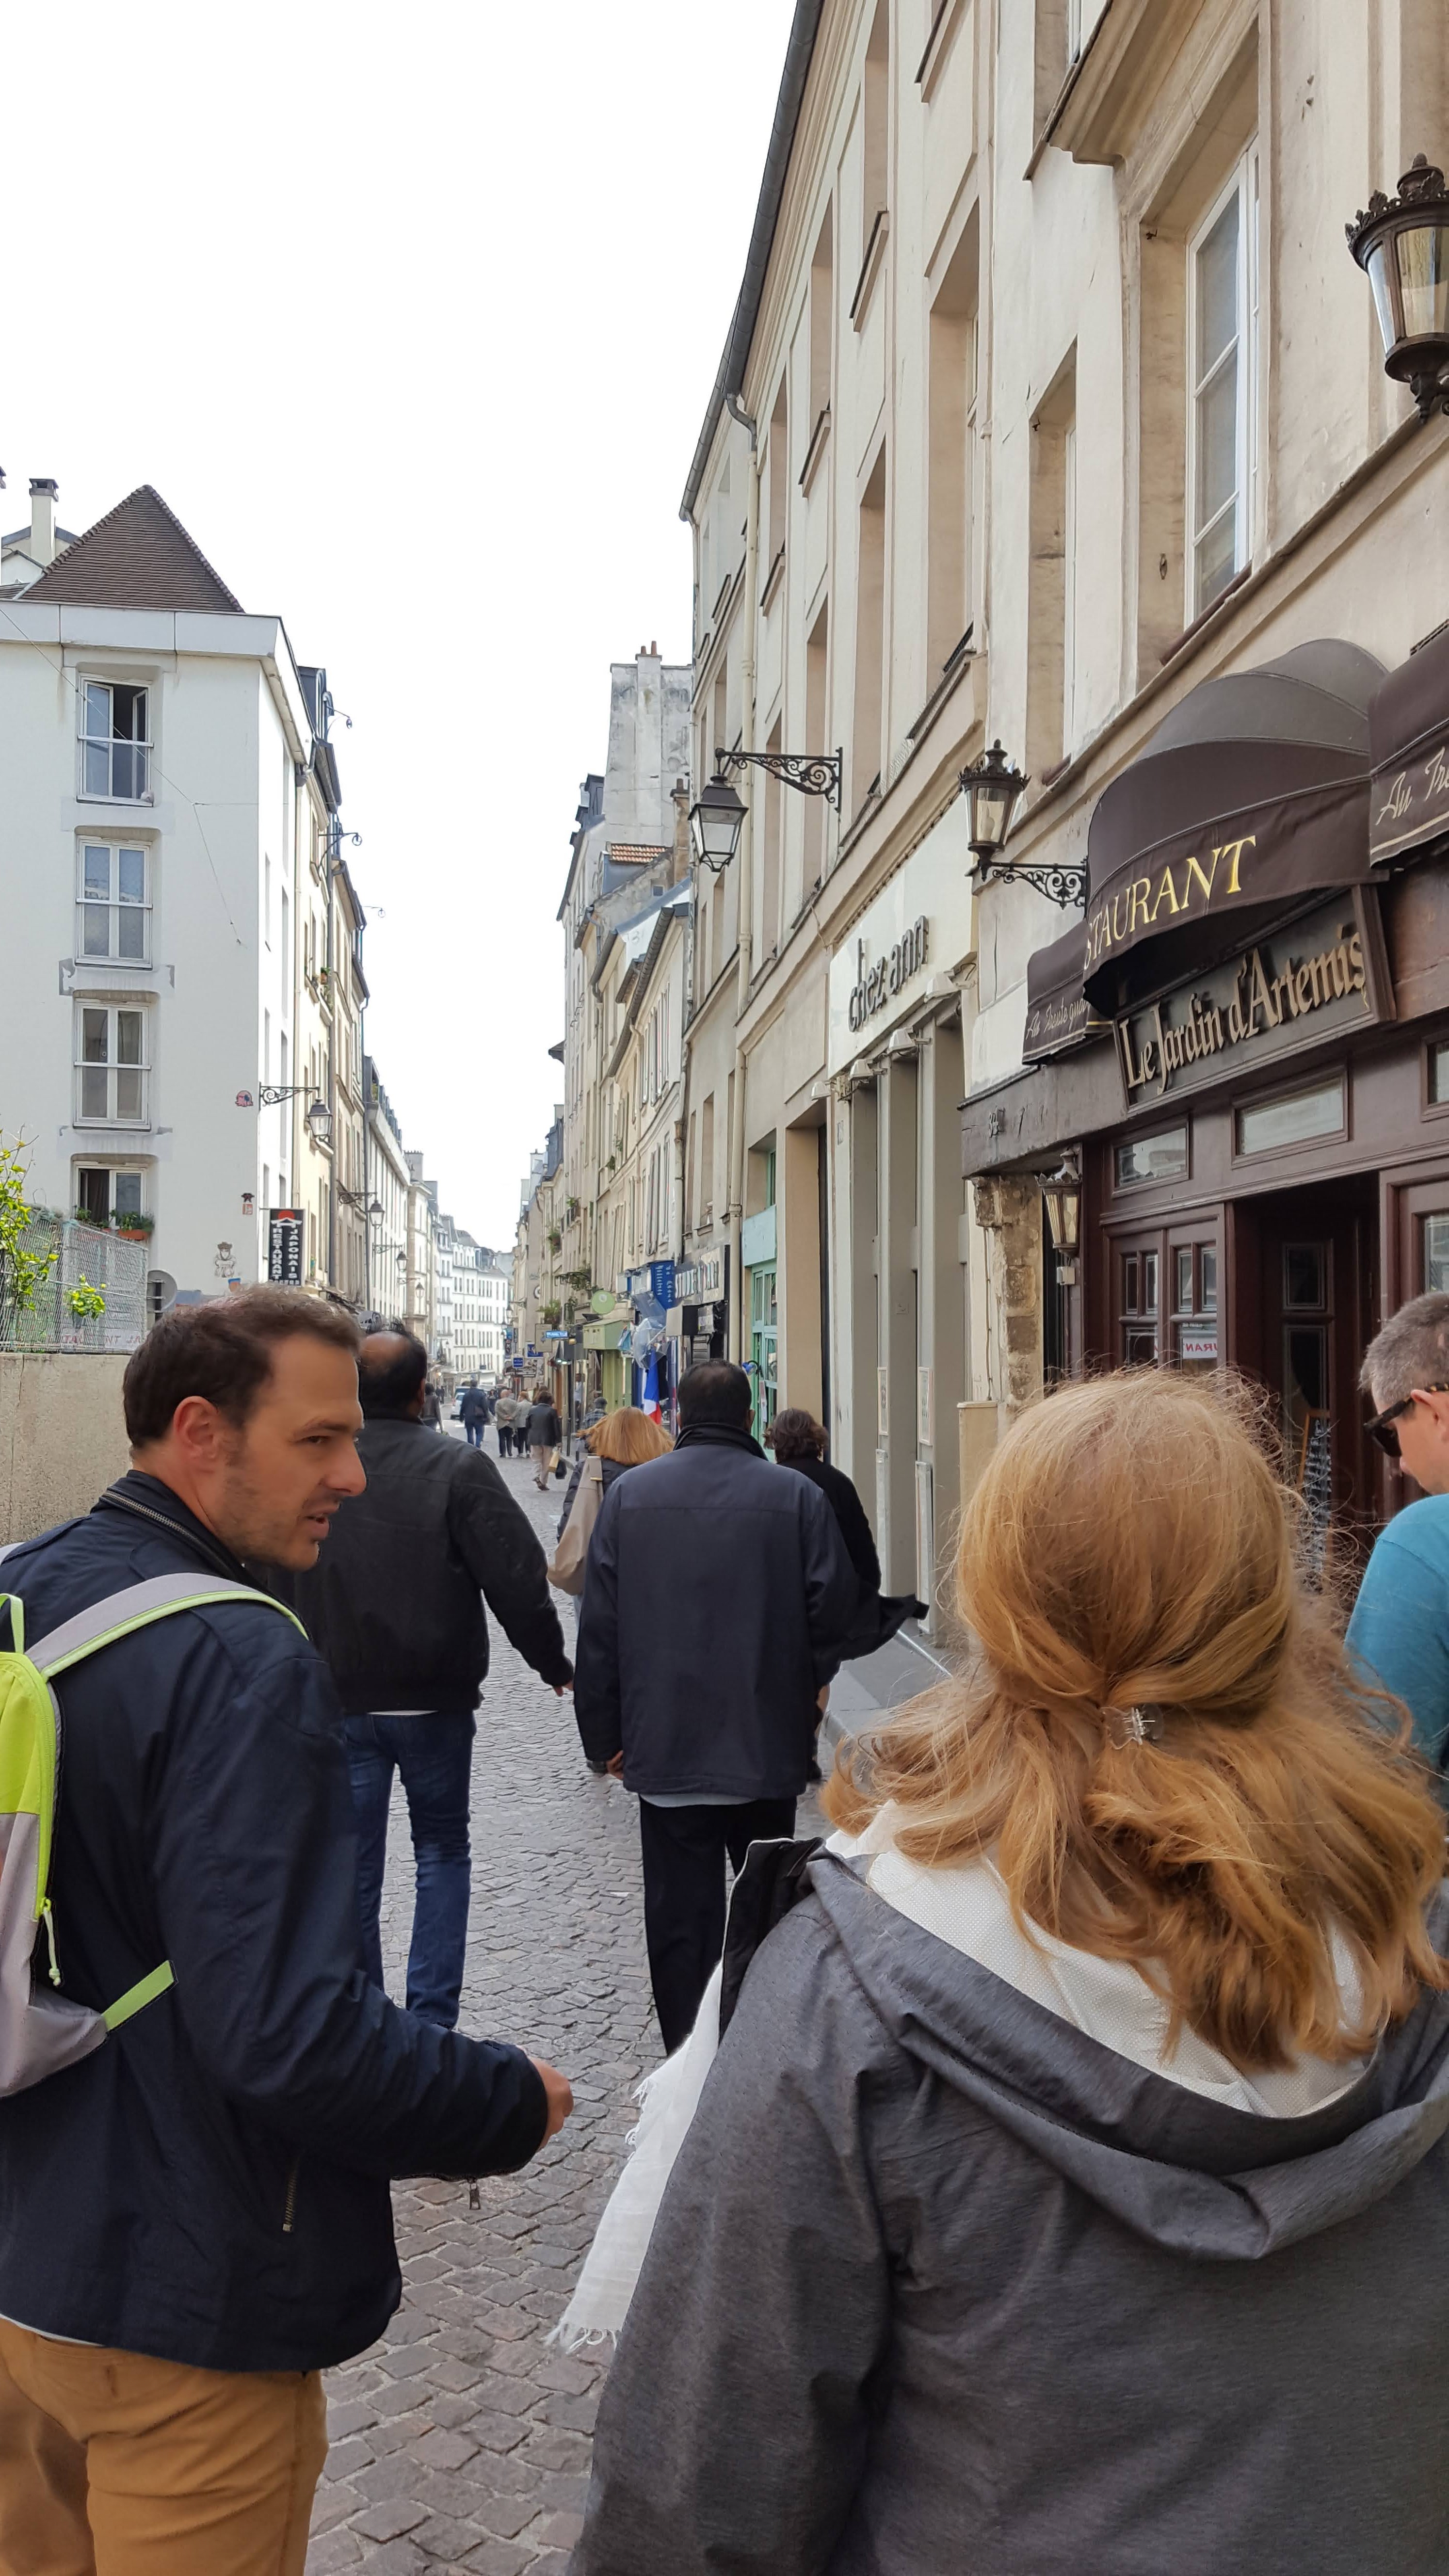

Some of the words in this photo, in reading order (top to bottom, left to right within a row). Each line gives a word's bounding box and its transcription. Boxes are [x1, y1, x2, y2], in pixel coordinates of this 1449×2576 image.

[1375, 772, 1413, 825] Au
[849, 938, 887, 1032] chez
[890, 915, 929, 995] ann
[1025, 1011, 1041, 1040] Au
[1044, 997, 1068, 1033] Trente
[1120, 1018, 1155, 1088] Le
[1150, 993, 1224, 1095] Jardin
[1229, 923, 1366, 1044] d'Artemis
[272, 1228, 283, 1279] RESTAURANT
[288, 1229, 299, 1279] JAPONAIS
